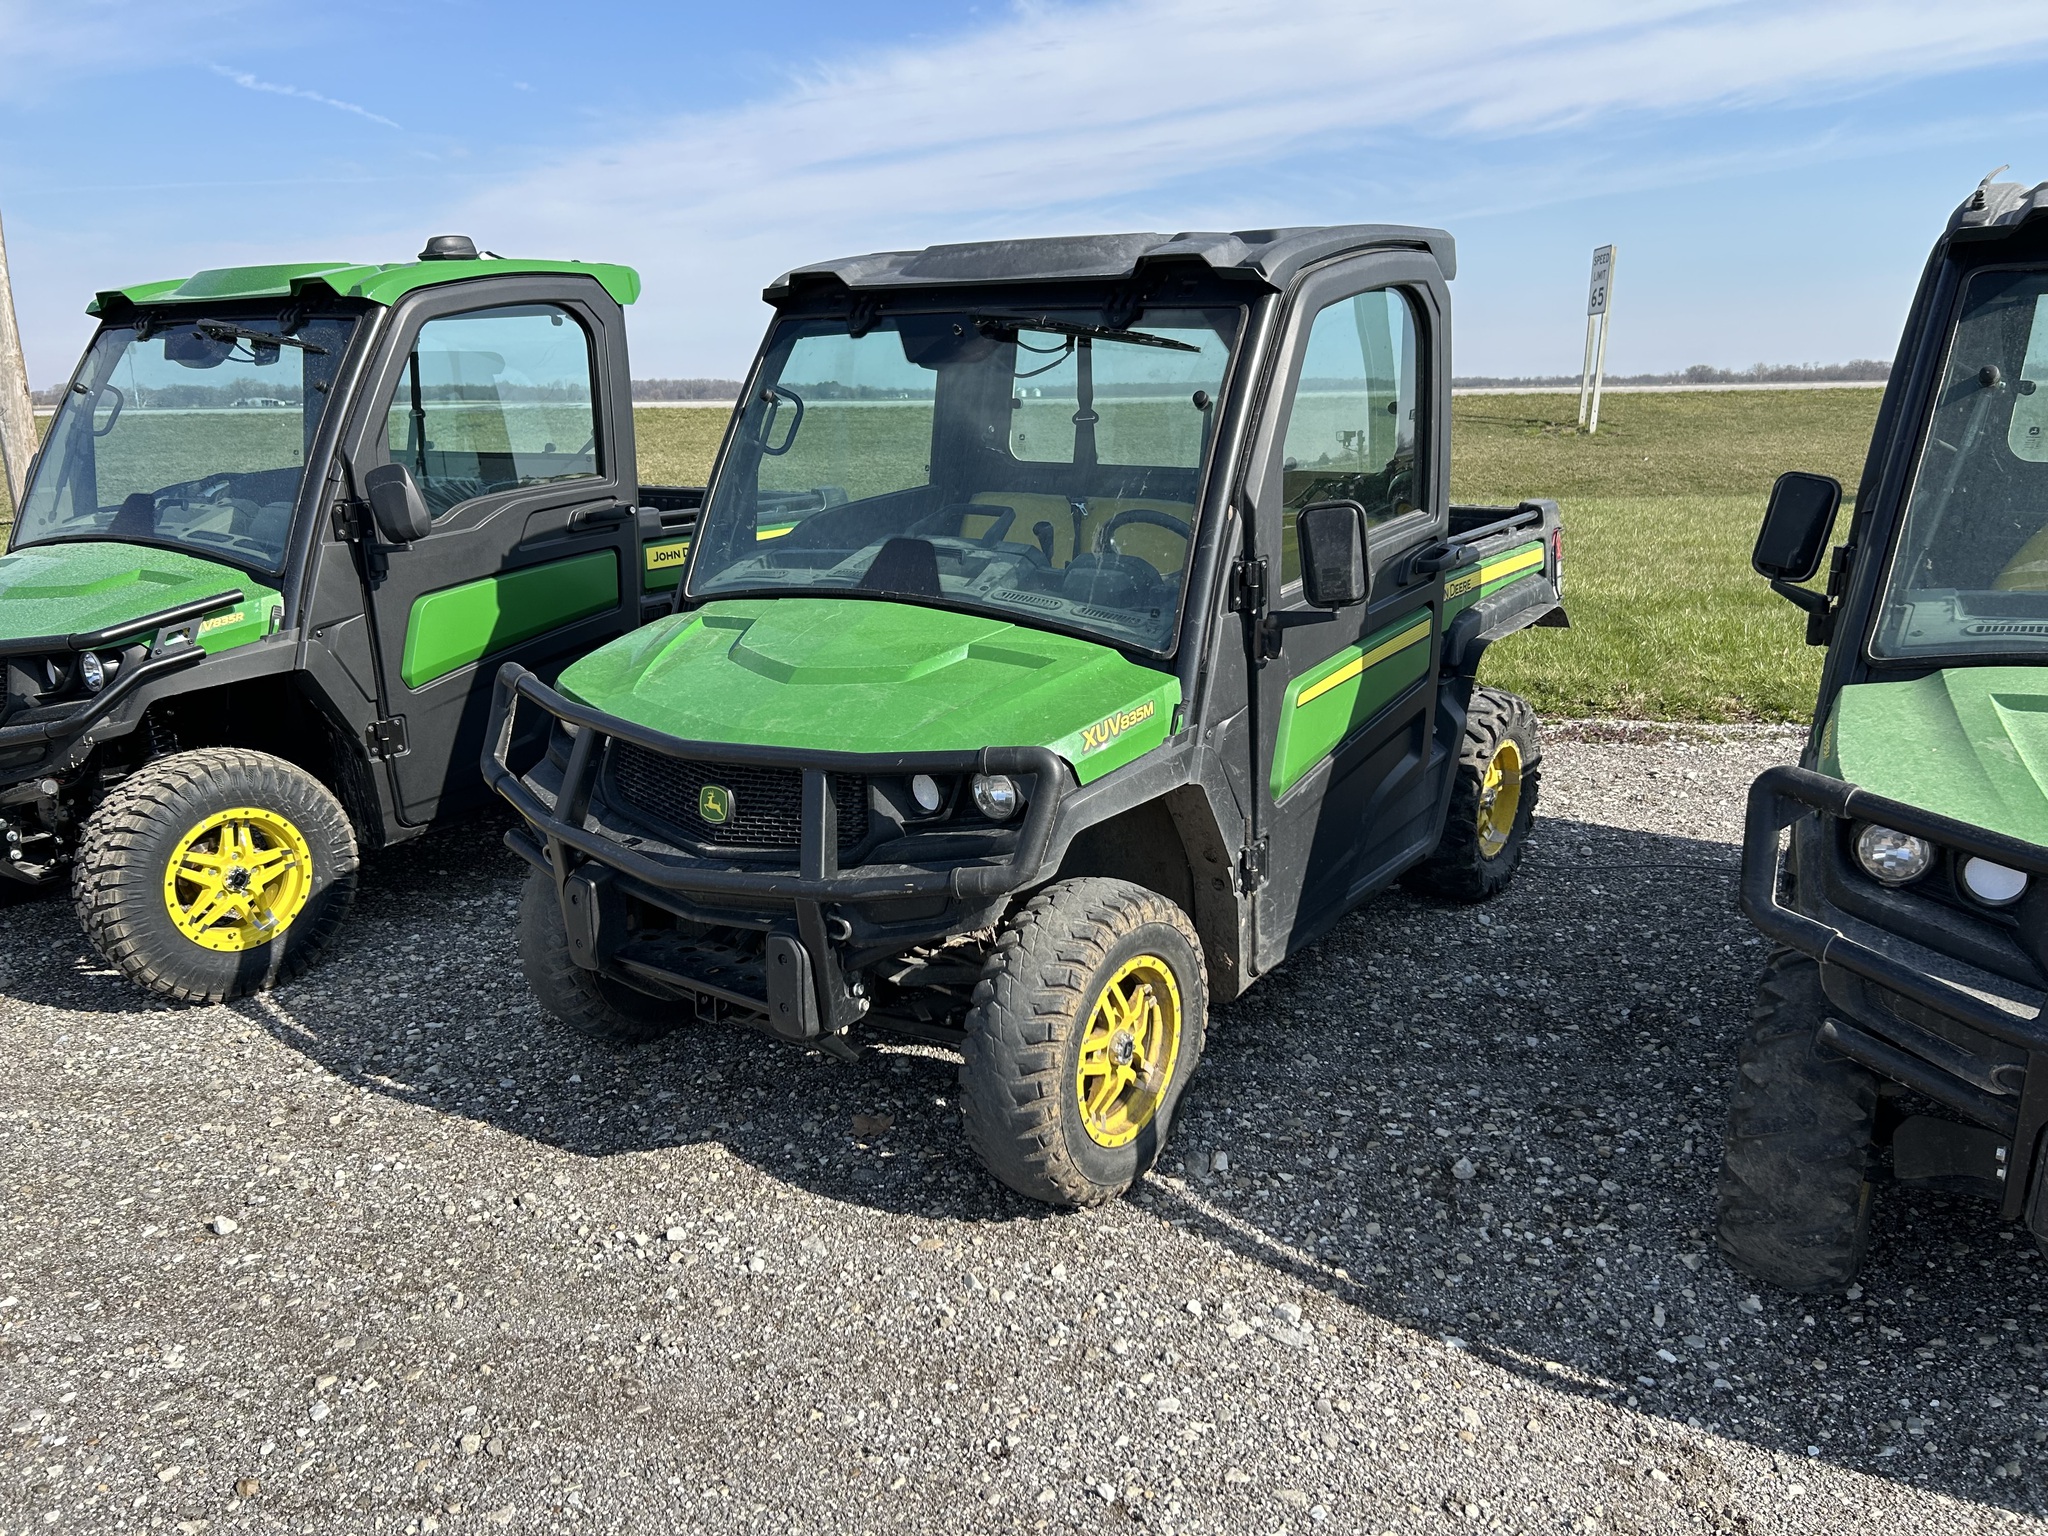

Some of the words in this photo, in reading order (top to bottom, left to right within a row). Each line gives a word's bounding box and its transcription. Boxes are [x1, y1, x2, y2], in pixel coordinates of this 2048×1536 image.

[1593, 252, 1610, 266] SPEED
[1593, 269, 1607, 282] LIMIT
[1591, 286, 1605, 307] 65
[653, 549, 682, 563] JOHN
[1450, 578, 1472, 597] DEERE
[198, 611, 245, 632] V835R
[1080, 699, 1155, 756] XUV835M
